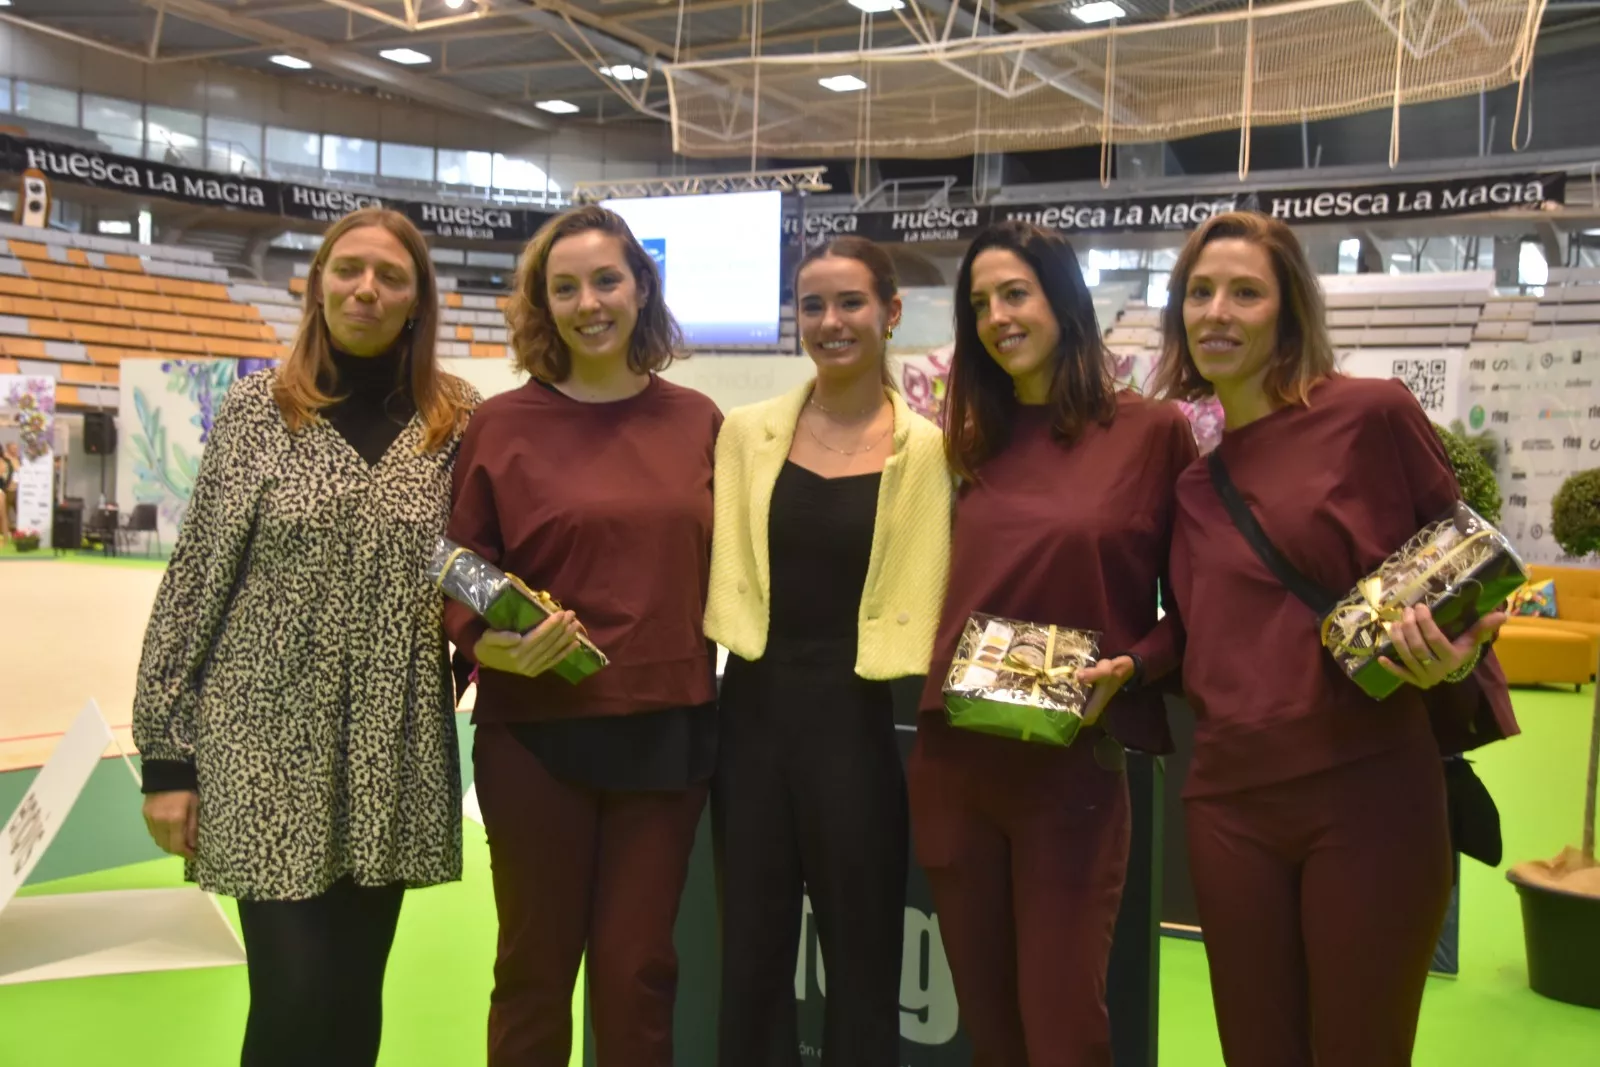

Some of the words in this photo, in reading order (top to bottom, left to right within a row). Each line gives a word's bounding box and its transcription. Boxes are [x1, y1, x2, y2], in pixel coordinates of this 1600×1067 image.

[26, 147, 141, 188] Huesca
[421, 203, 512, 228] Huesca
[1271, 191, 1389, 219] Huesca
[892, 207, 979, 230] Huesca
